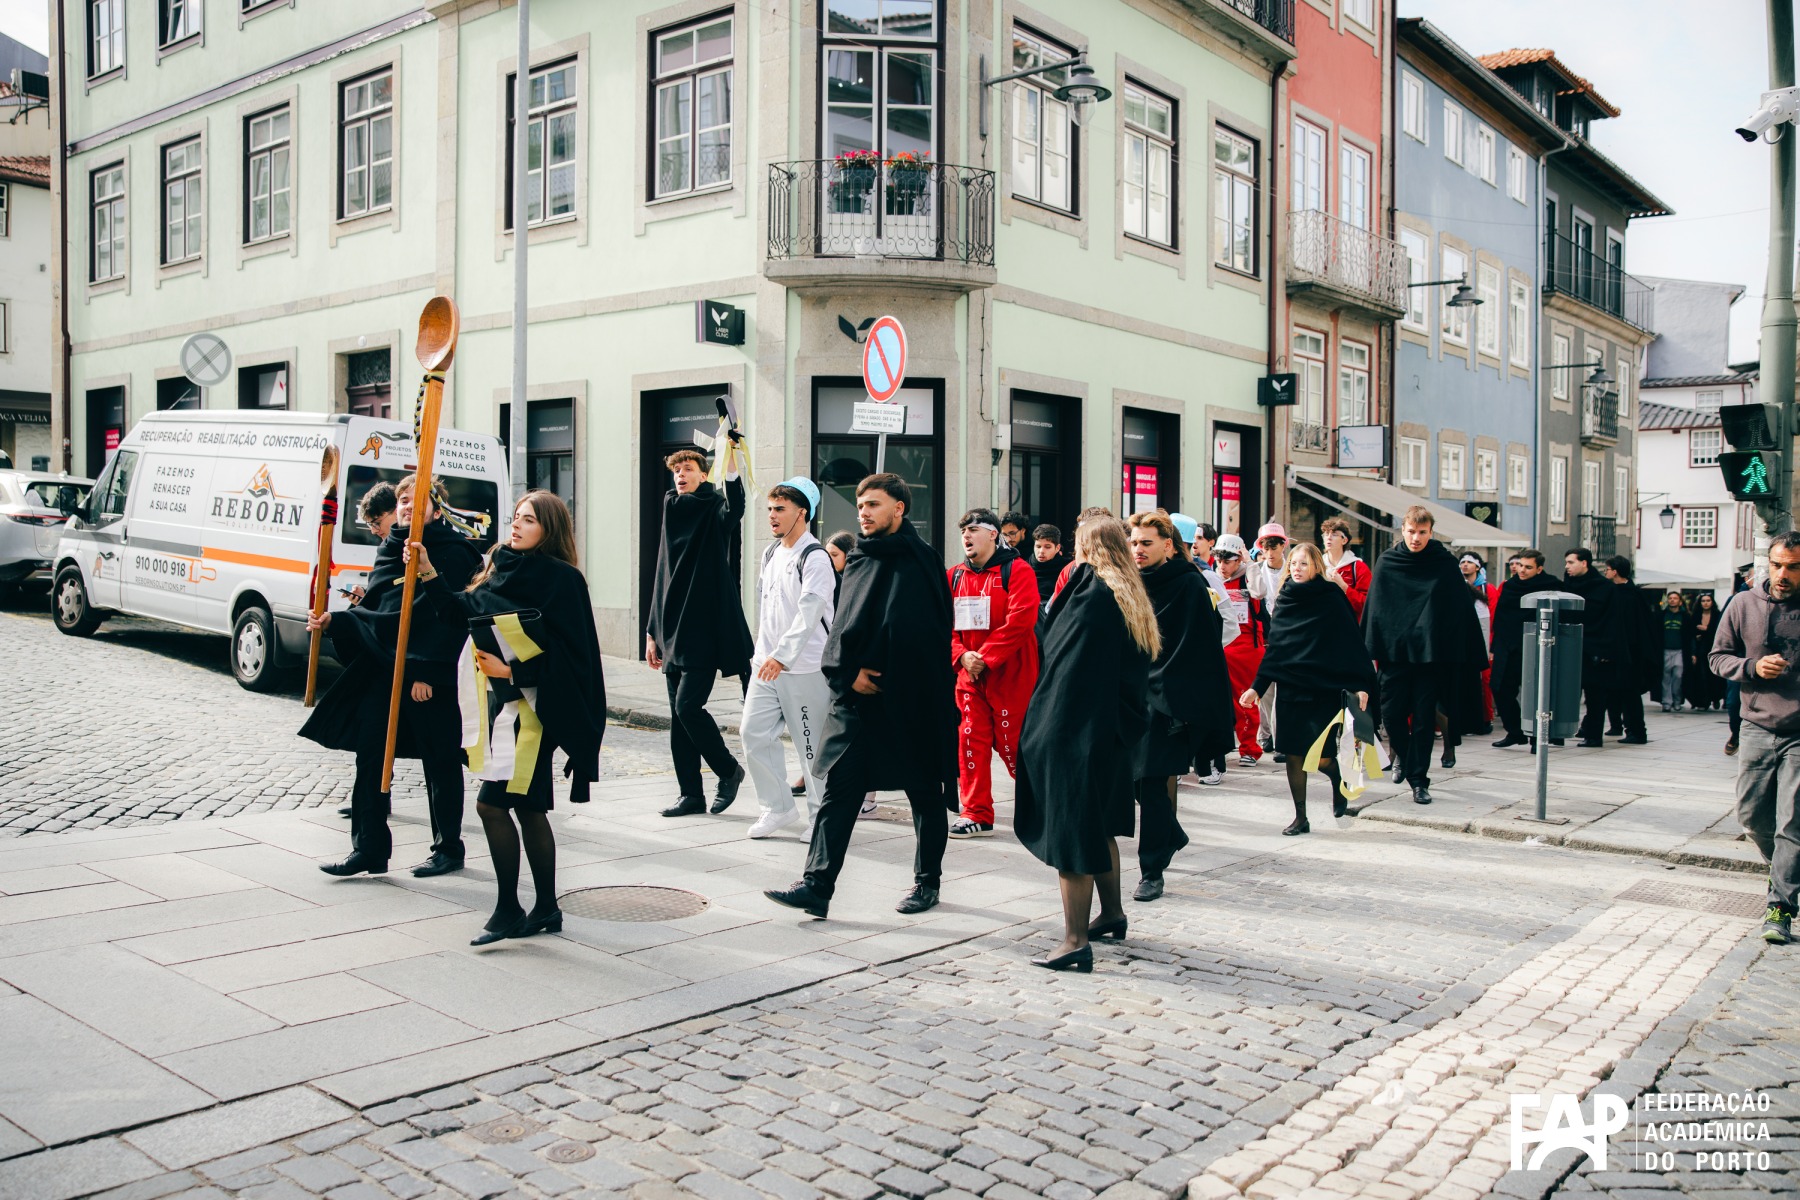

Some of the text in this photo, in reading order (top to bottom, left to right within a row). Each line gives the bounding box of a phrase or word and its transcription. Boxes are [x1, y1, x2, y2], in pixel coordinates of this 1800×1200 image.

[18, 413, 48, 423] VELHA
[140, 429, 328, 451] RECUPERAÇÃO REABILITAÇÃO CONSTRUÇÃO
[439, 437, 486, 451] FAZEMOS
[385, 445, 412, 453] PROJETOS
[439, 449, 486, 462] RENASCER
[156, 466, 195, 478] FAZEMOS
[447, 461, 463, 470] SUA
[465, 464, 486, 473] CASA
[153, 482, 191, 496] RENASCER
[150, 501, 187, 513] A SUA CASA
[211, 496, 304, 526] REBORN
[136, 555, 186, 577] 910 010 918
[135, 576, 186, 593] REBORNSOLUTIONS.PT
[800, 705, 814, 760] CALOIRO
[963, 693, 976, 770] CALOIRO
